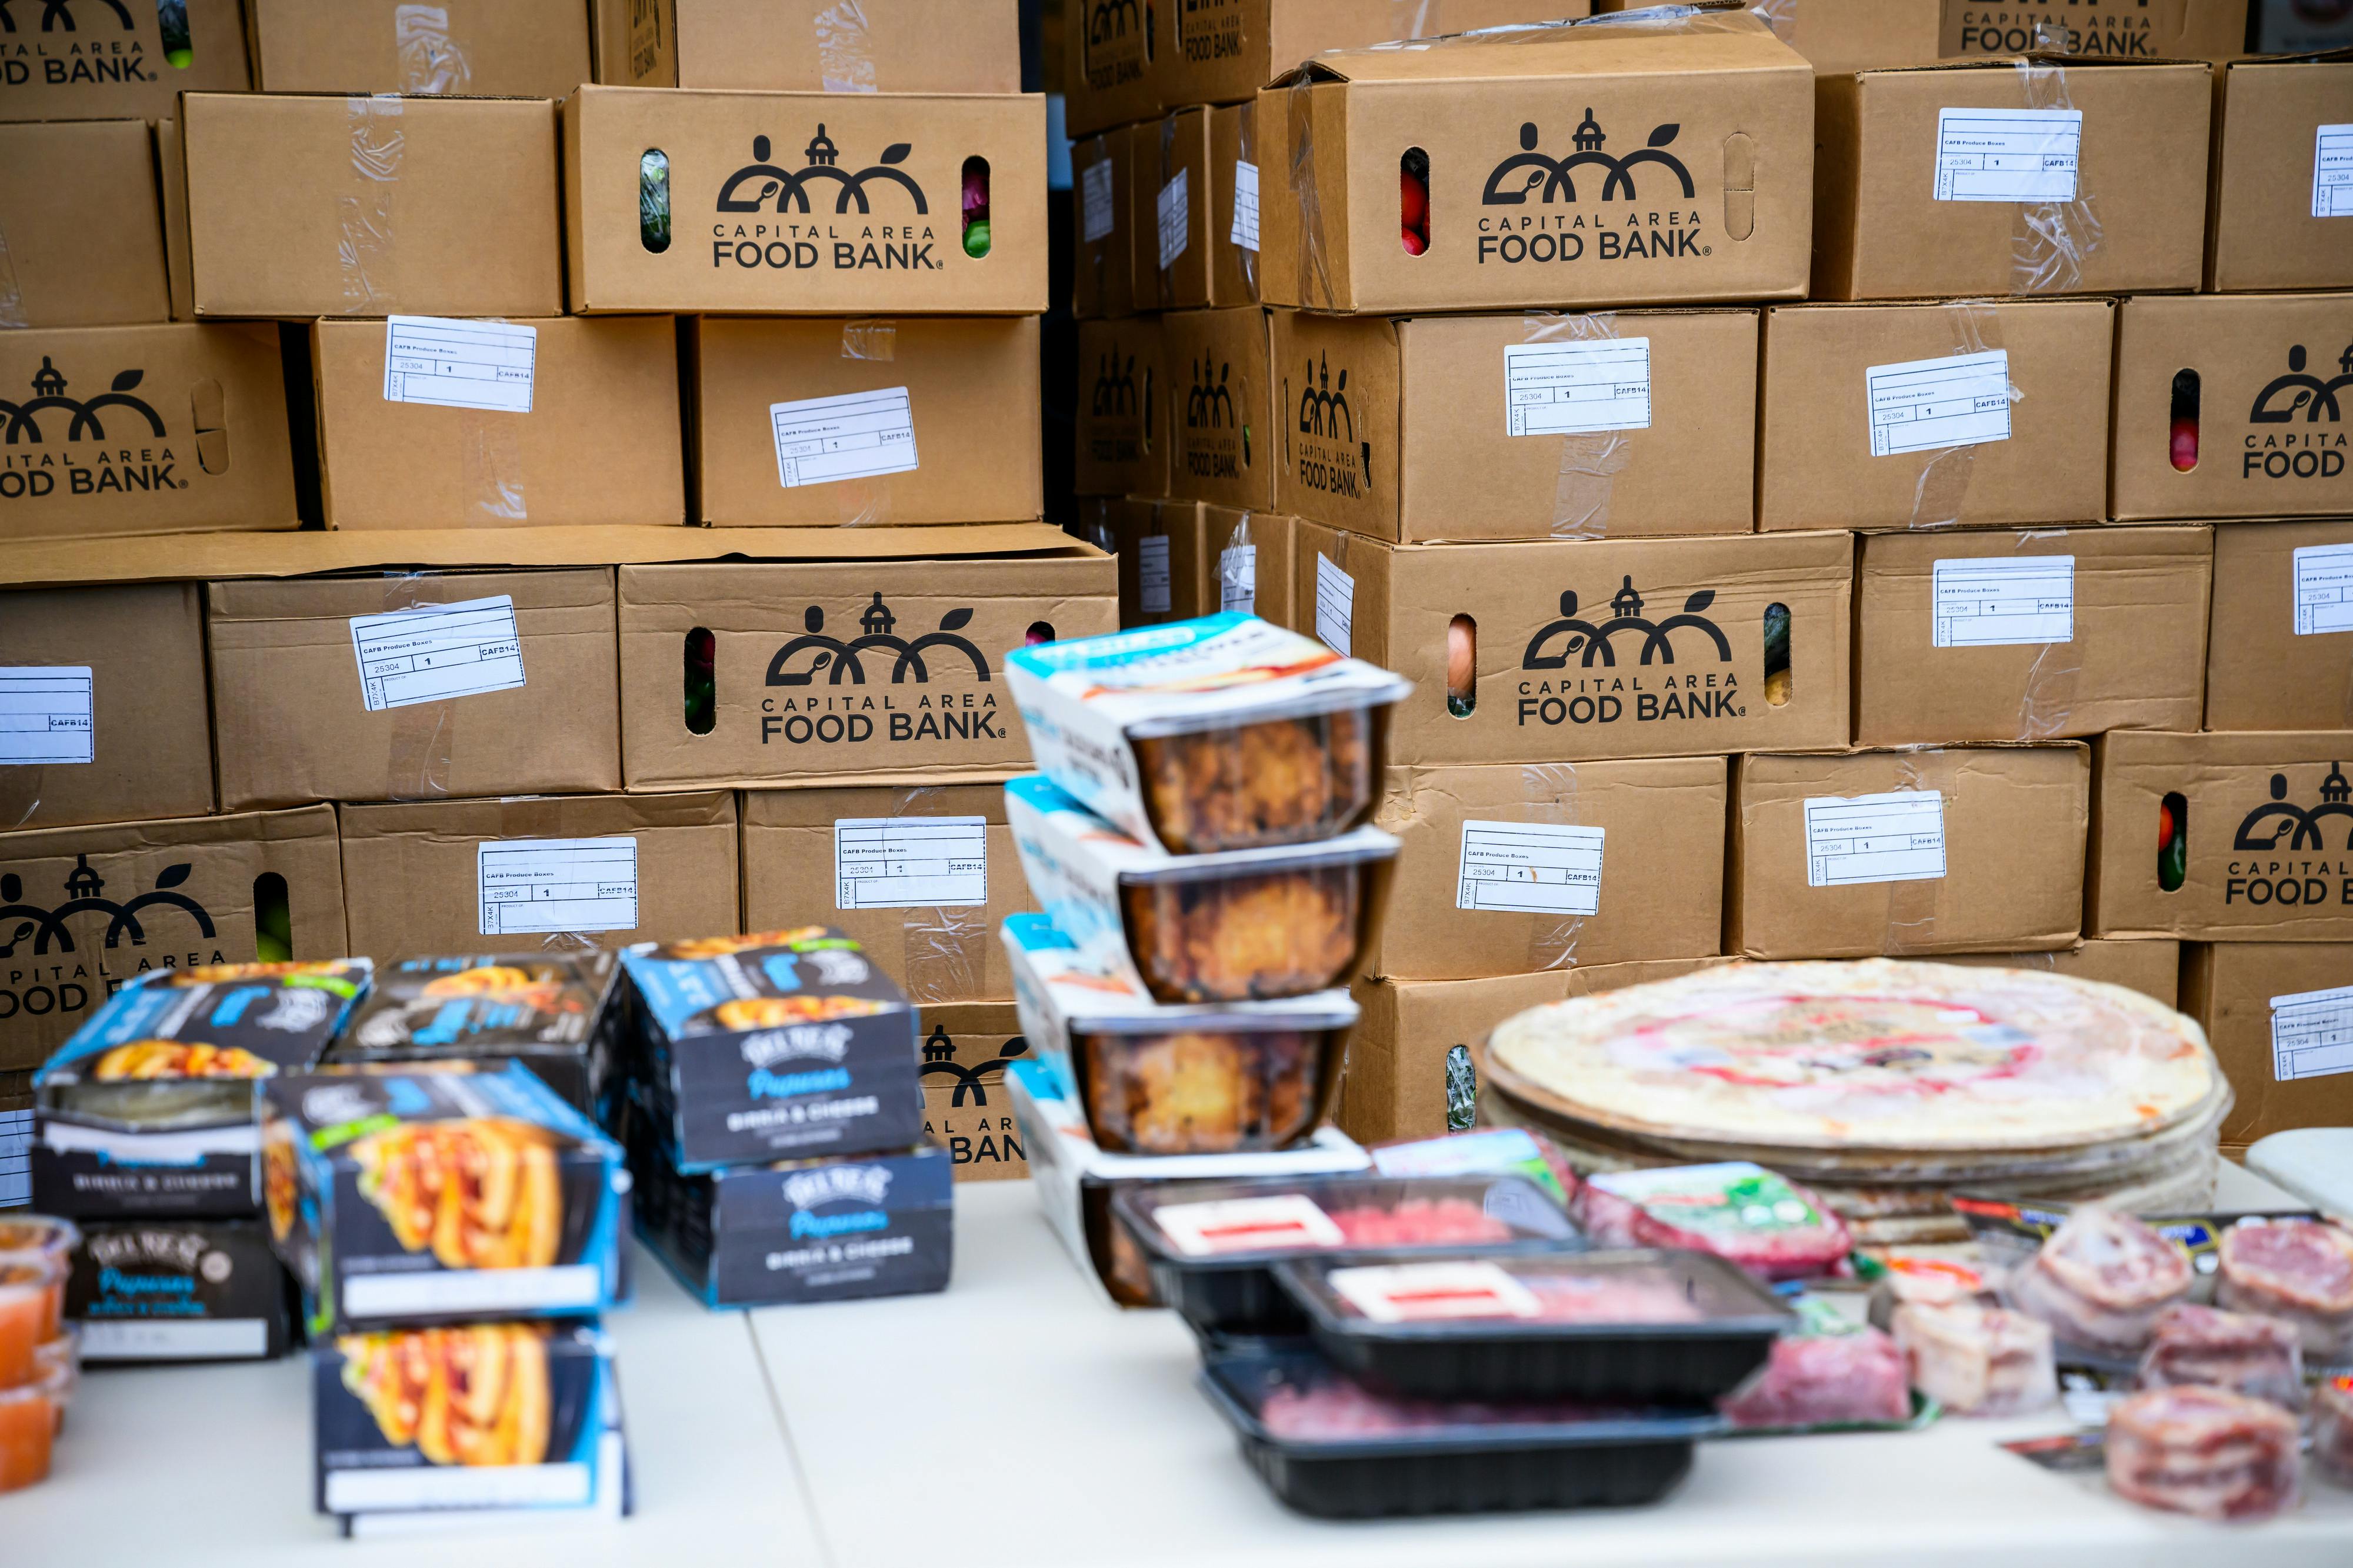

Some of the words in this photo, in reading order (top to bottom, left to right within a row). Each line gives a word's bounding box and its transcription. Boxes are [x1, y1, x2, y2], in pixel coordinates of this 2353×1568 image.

[1964, 12, 2068, 27] CAPITAL
[2088, 16, 2151, 28] AREA
[71, 41, 143, 55] AREA
[1186, 35, 1211, 62] FOOD
[713, 224, 839, 238] CAPITAL
[861, 226, 934, 239] AREA
[1478, 215, 1604, 232] CAPITAL
[1627, 211, 1701, 226] AREA
[714, 241, 818, 269] FOOD
[1478, 233, 1584, 263] FOOD
[1976, 399, 2005, 408] CAFB14
[1883, 412, 1904, 421] 25304
[881, 432, 910, 441] CAFB14
[6, 452, 74, 468] ITAL
[97, 448, 174, 464] AREA
[1188, 451, 1210, 477] FOOD
[1299, 443, 1331, 462] CAPITAL
[1337, 452, 1356, 468] AREA
[2244, 451, 2345, 478] FOOD
[1300, 459, 1327, 490] FOOD
[384, 642, 410, 650] Produce
[482, 645, 515, 655] CAFB14
[375, 663, 399, 673] 25304
[1518, 678, 1642, 695] CAPITAL
[1664, 673, 1738, 689] AREA
[761, 696, 895, 712] CAPITAL
[918, 693, 997, 708] AREA
[1518, 696, 1622, 726] FOOD
[762, 714, 873, 744] FOOD
[2228, 861, 2348, 875] CAPITAL
[2226, 878, 2327, 905] FOOD
[10, 963, 111, 985] PITAL
[138, 950, 225, 972] AREA
